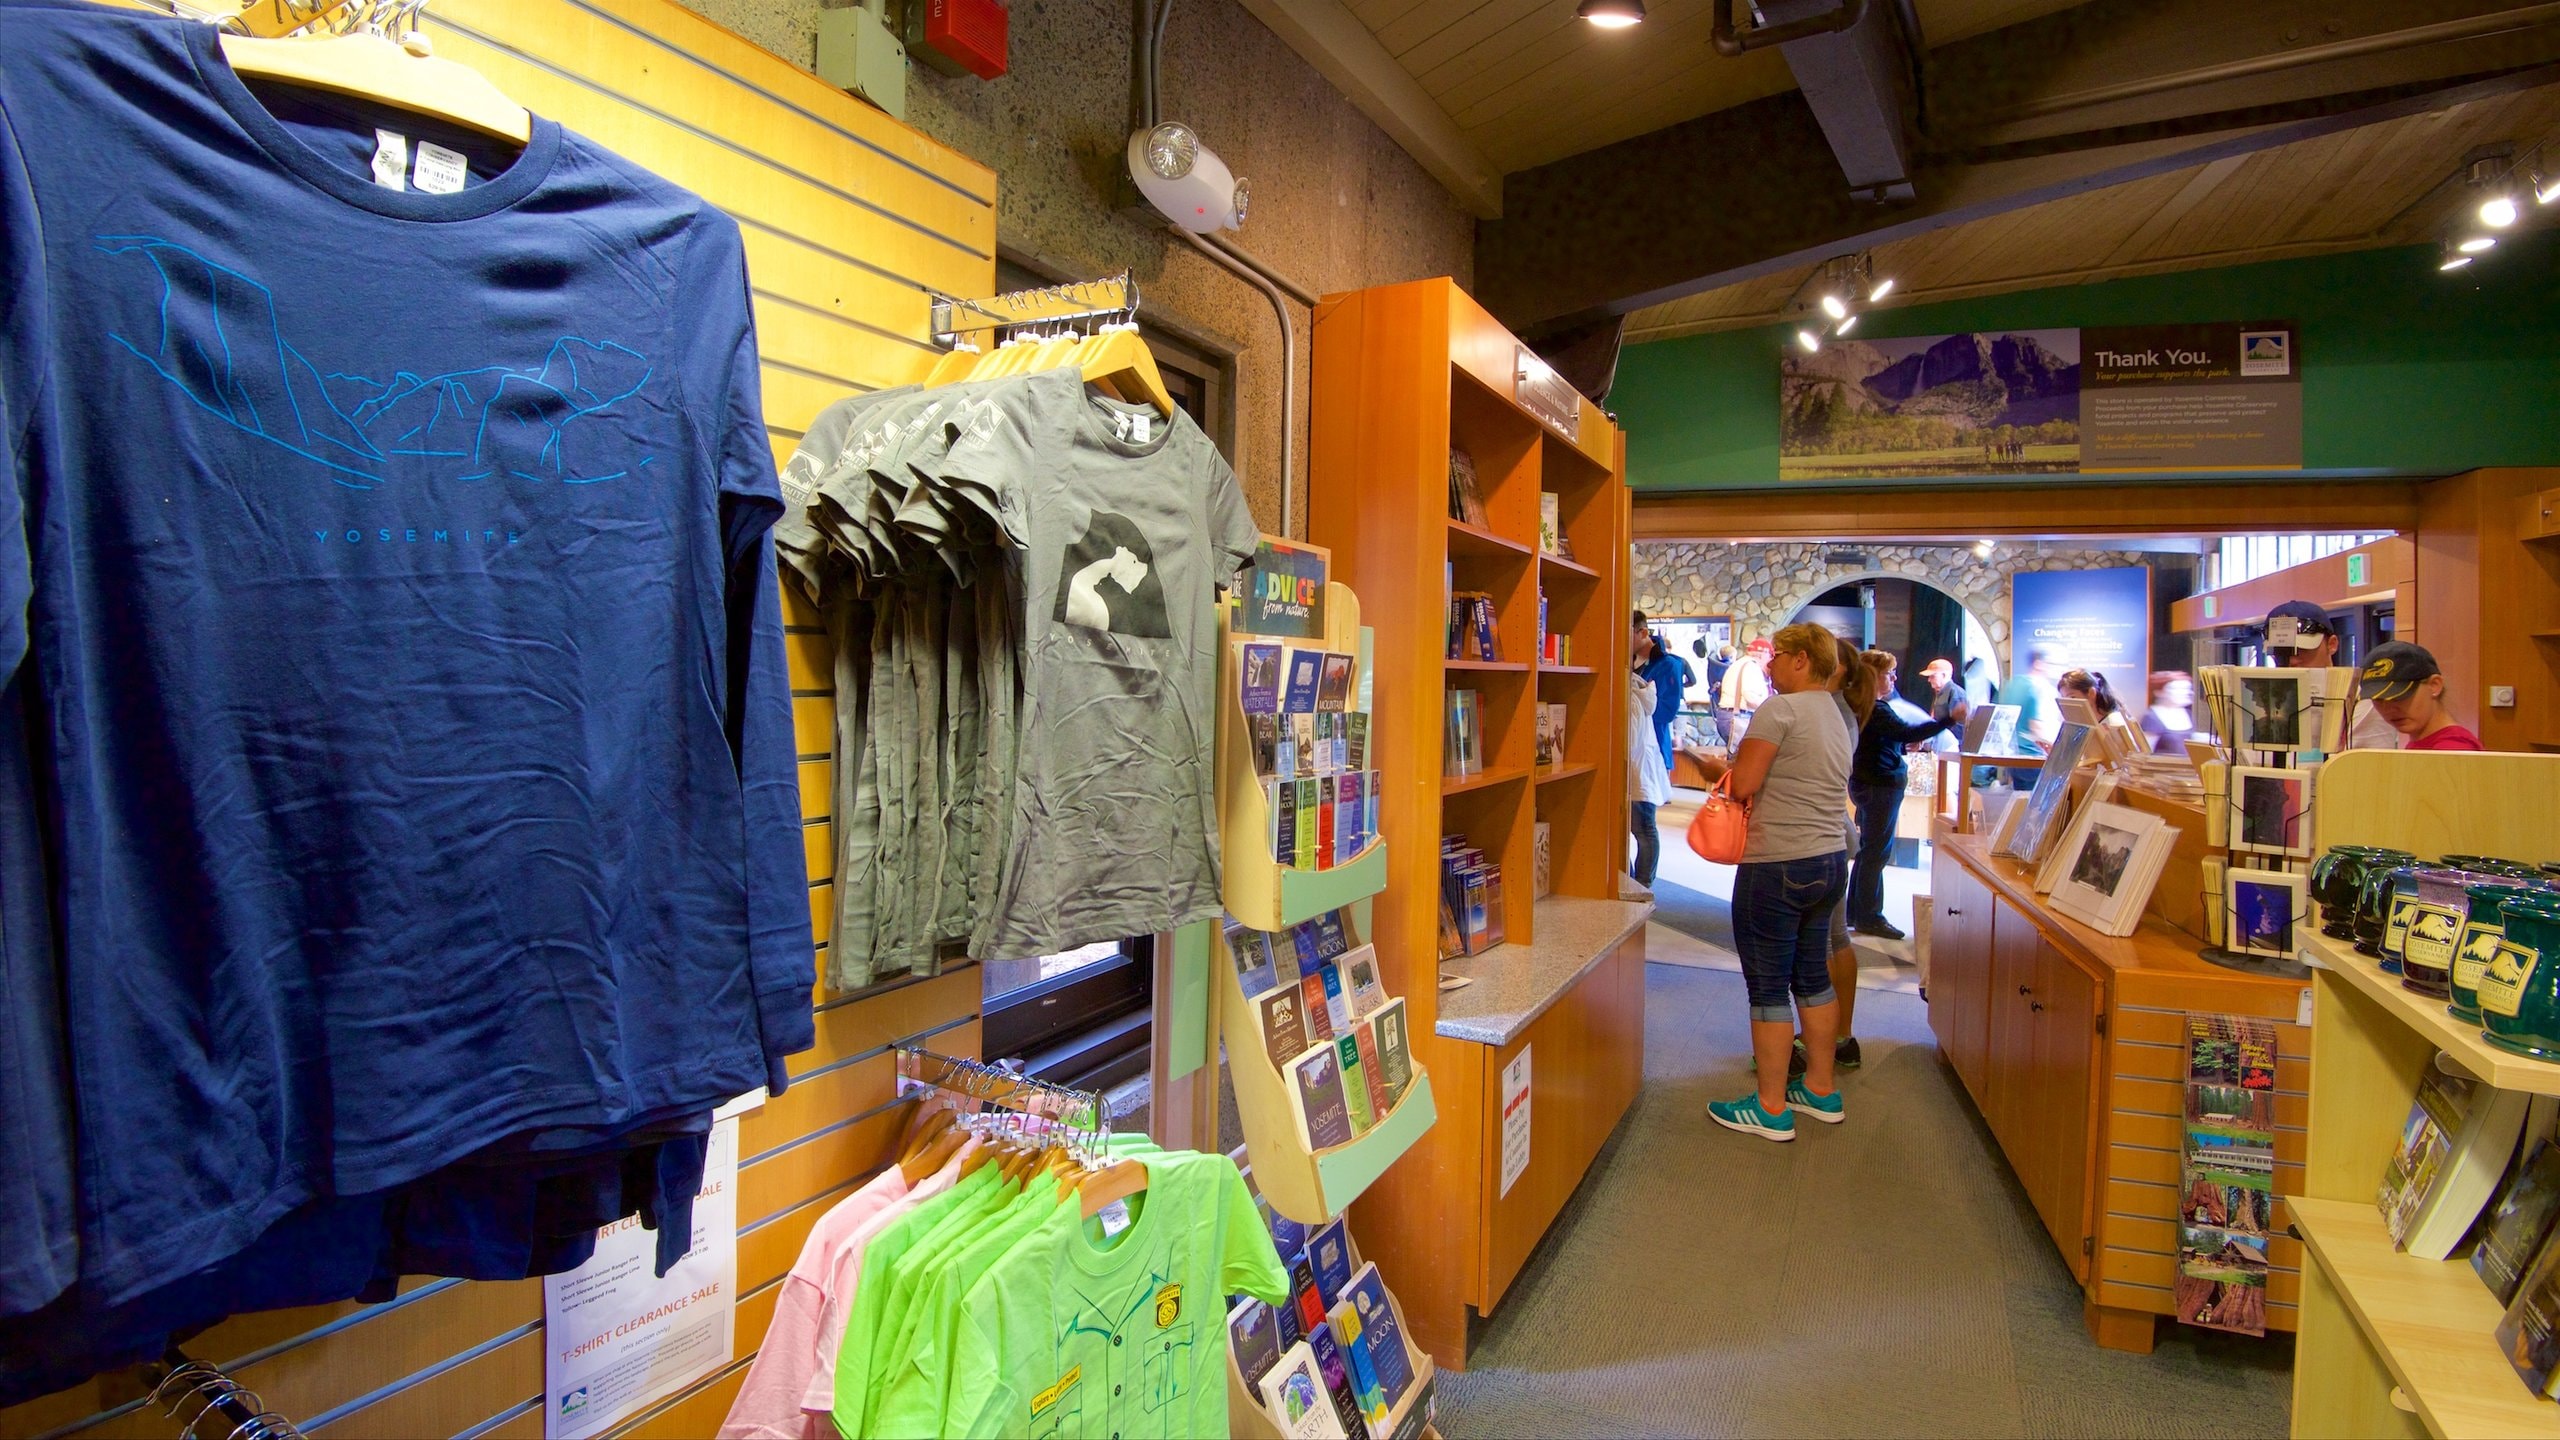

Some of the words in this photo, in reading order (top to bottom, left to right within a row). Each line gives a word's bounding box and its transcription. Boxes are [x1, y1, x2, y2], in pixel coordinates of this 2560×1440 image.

[2094, 350, 2160, 367] Thank
[2165, 349, 2212, 365] You.
[2095, 371, 2117, 380] Your
[2117, 371, 2155, 382] purchase
[2156, 370, 2191, 381] supports
[2193, 368, 2206, 378] the
[2207, 368, 2231, 379] park.
[314, 529, 522, 545] YOSEMITE
[1254, 570, 1315, 606] ADVICE
[1263, 592, 1284, 620] from
[1285, 601, 1310, 619] nature.
[1049, 633, 1172, 658] YOSEMITE
[2034, 627, 2076, 639] Changing
[2079, 627, 2105, 637] Faces
[1317, 939, 1345, 960] MOON
[1310, 1102, 1343, 1132] YOSEMITE
[560, 1330, 612, 1364] T-SHIRT
[615, 1296, 688, 1338] CLEARANCE
[691, 1282, 720, 1304] SALE
[1367, 1316, 1394, 1353] MOON
